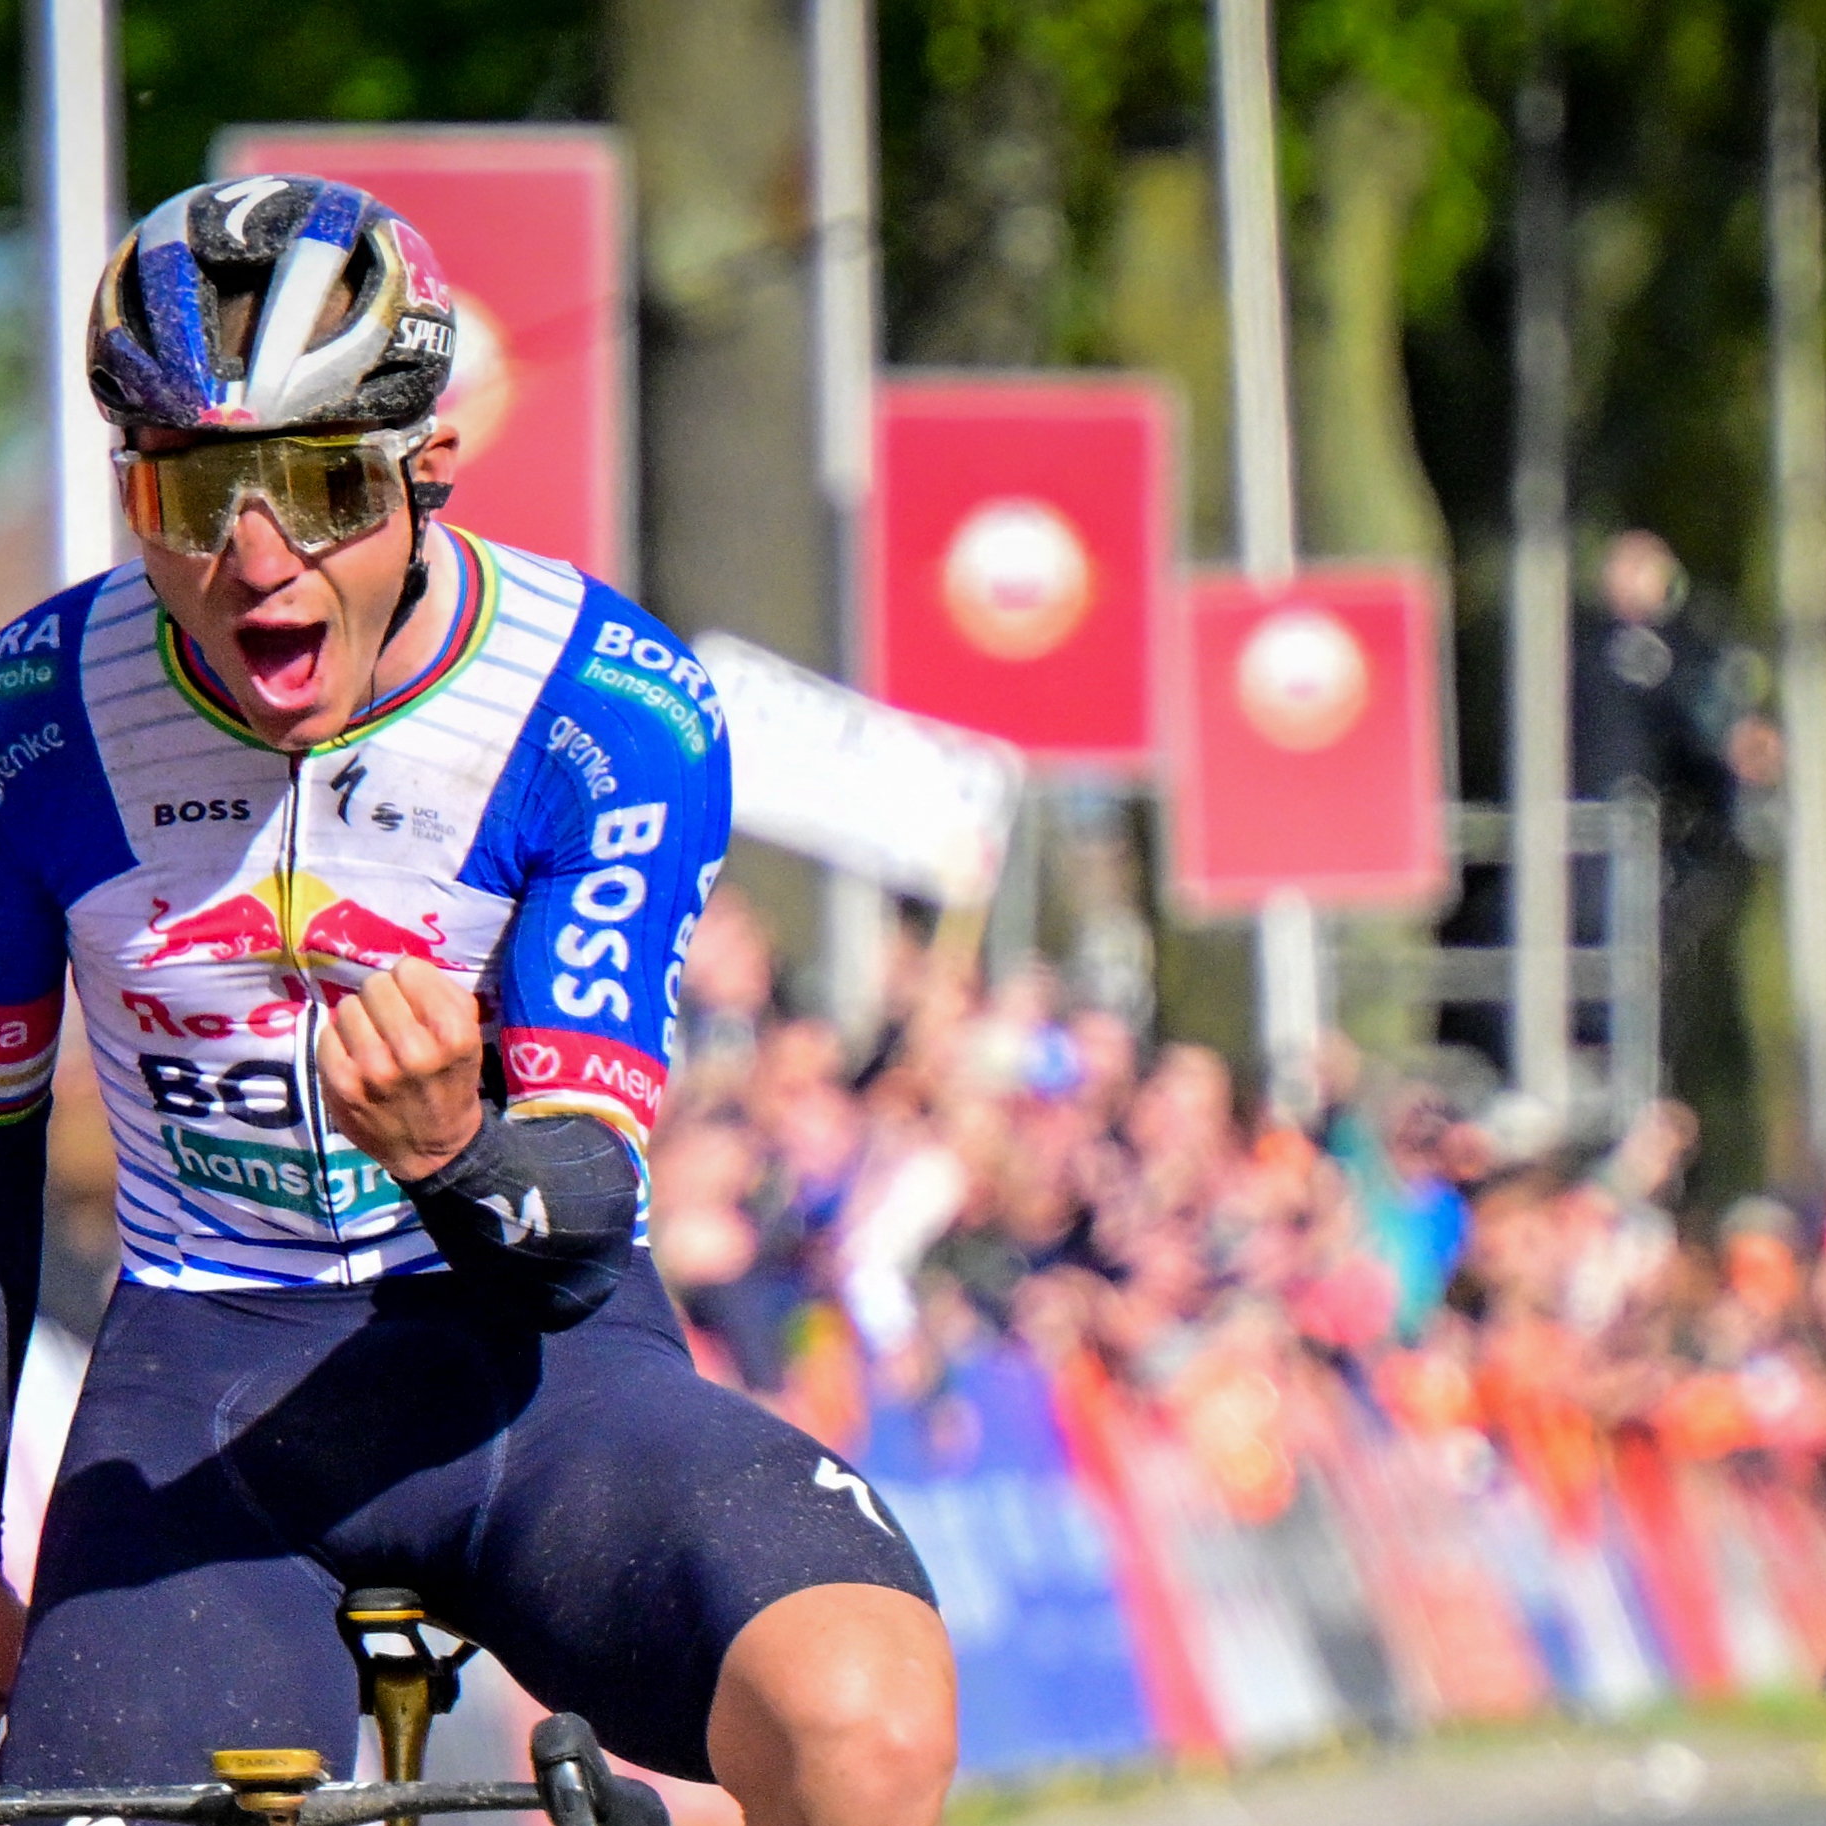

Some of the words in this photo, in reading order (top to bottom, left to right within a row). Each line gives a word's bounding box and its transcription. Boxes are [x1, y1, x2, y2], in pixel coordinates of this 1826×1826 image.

[584, 657, 707, 754] hansgrohe
[593, 621, 724, 741] BORA
[547, 715, 618, 800] grenke
[154, 800, 251, 827] BOSS
[411, 828, 444, 844] TEAM
[412, 806, 438, 820] UCI
[412, 818, 456, 835] WORLD
[553, 802, 667, 1022] BOSS
